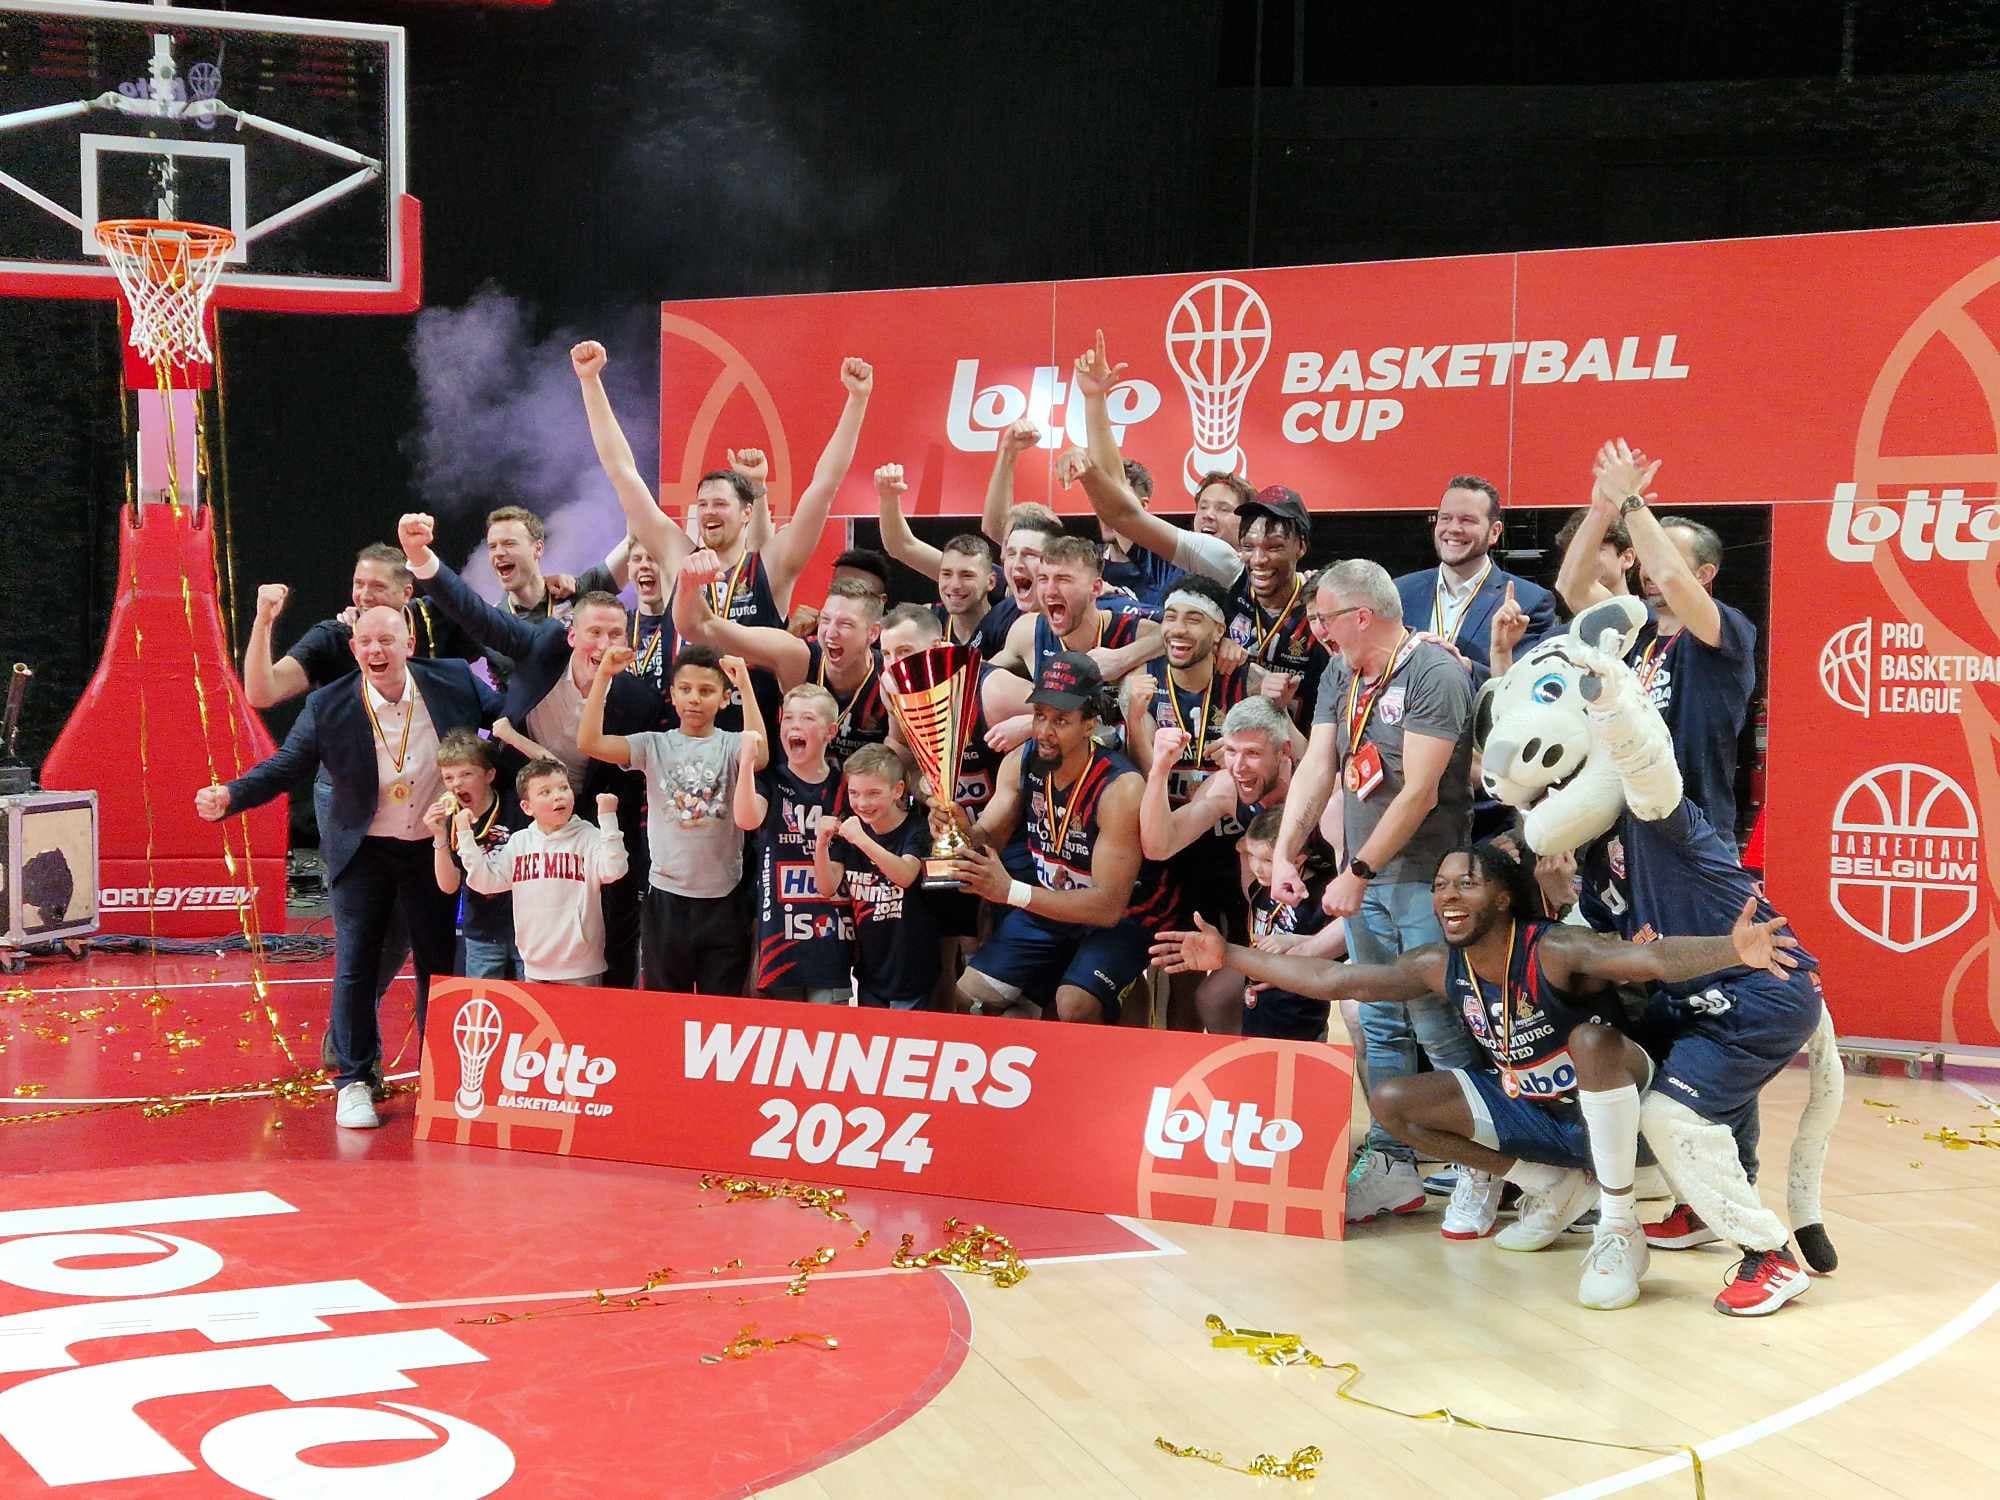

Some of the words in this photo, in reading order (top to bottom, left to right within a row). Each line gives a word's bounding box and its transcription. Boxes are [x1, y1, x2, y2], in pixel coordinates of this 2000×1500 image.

[1281, 334, 1690, 394] BASKETBALL
[1281, 399, 1404, 443] CUP
[1881, 622, 1924, 649] PRO
[1879, 686, 1962, 714] LEAGUE
[794, 804, 823, 836] 14
[1831, 834, 1978, 861] BASKETBALL
[512, 852, 540, 882] AKE
[846, 870, 873, 885] THE
[1830, 856, 1977, 881] BELGIUM
[501, 1033, 616, 1098] lotto
[683, 1021, 1034, 1109] WINNERS
[1519, 1063, 1575, 1094] ubo
[497, 1095, 581, 1114] BASKETBALL
[584, 1103, 613, 1116] CUP
[751, 1099, 933, 1174] 2024
[1144, 1086, 1303, 1168] lotto
